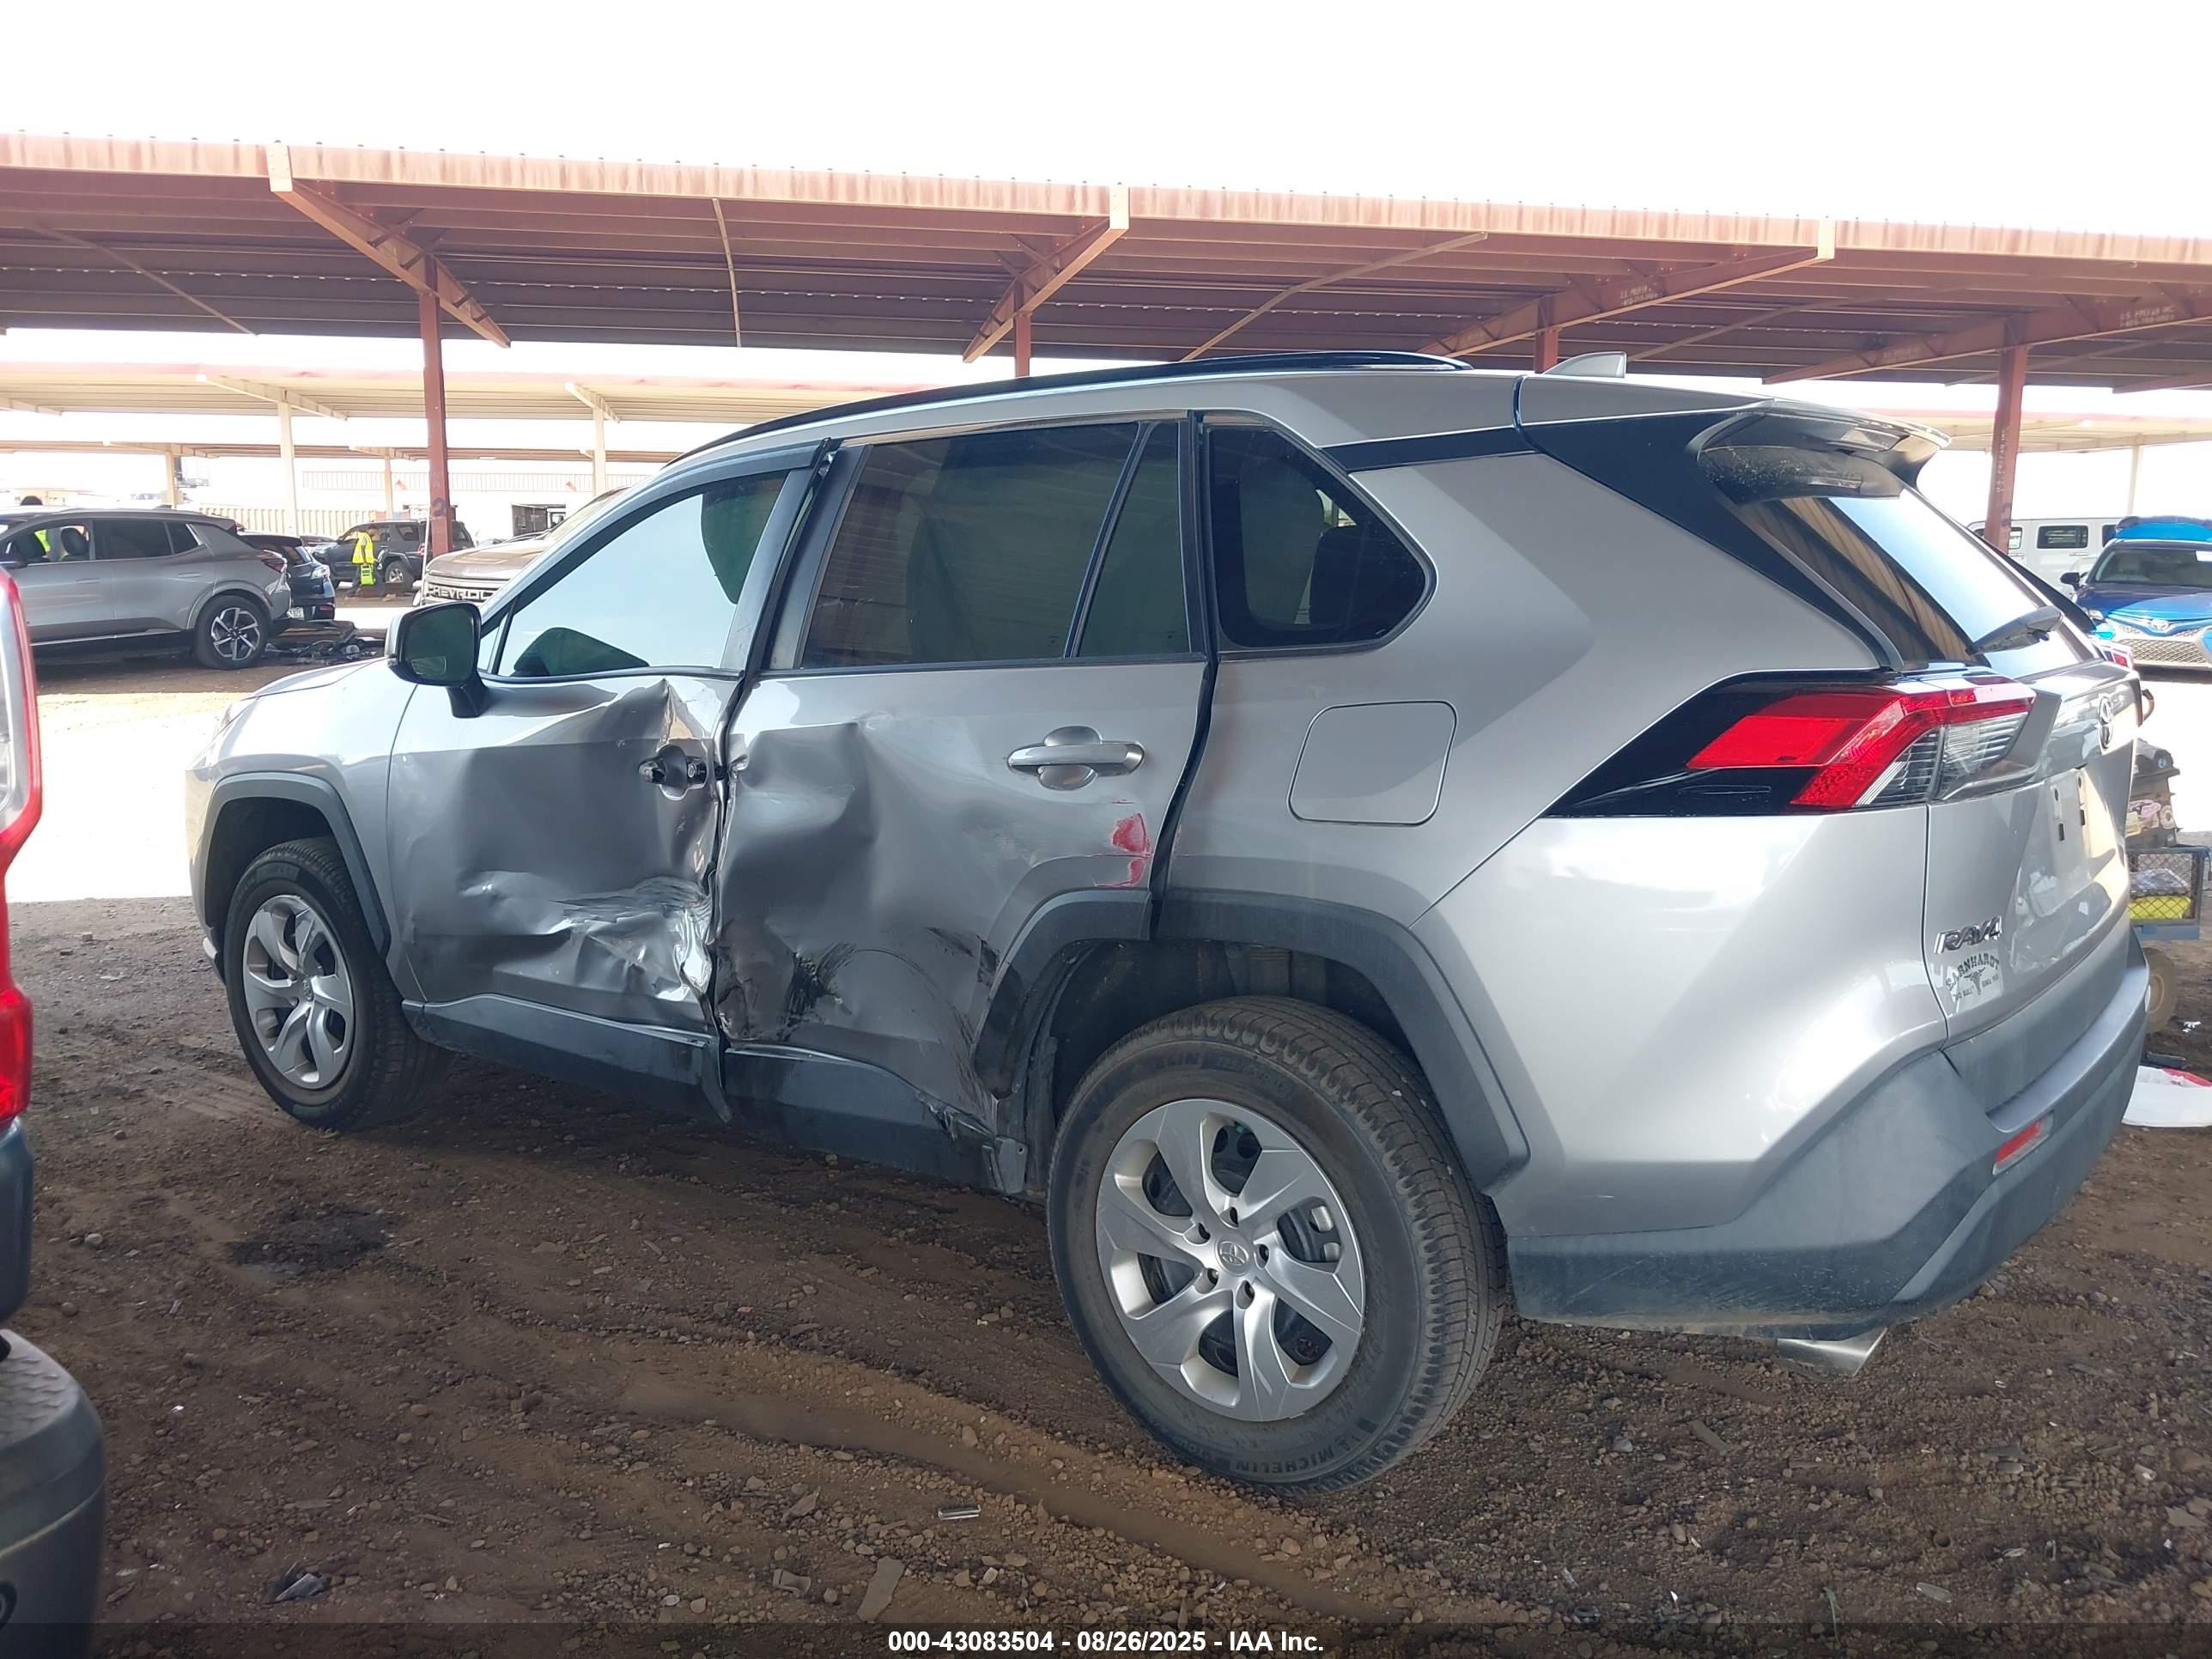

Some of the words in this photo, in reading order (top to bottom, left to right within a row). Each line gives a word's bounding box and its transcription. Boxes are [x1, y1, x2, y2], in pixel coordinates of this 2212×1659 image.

[1934, 915, 2002, 955] RAV4
[1945, 952, 2000, 991] EARNHARDT
[1235, 1447, 1334, 1474] MICHELIN
